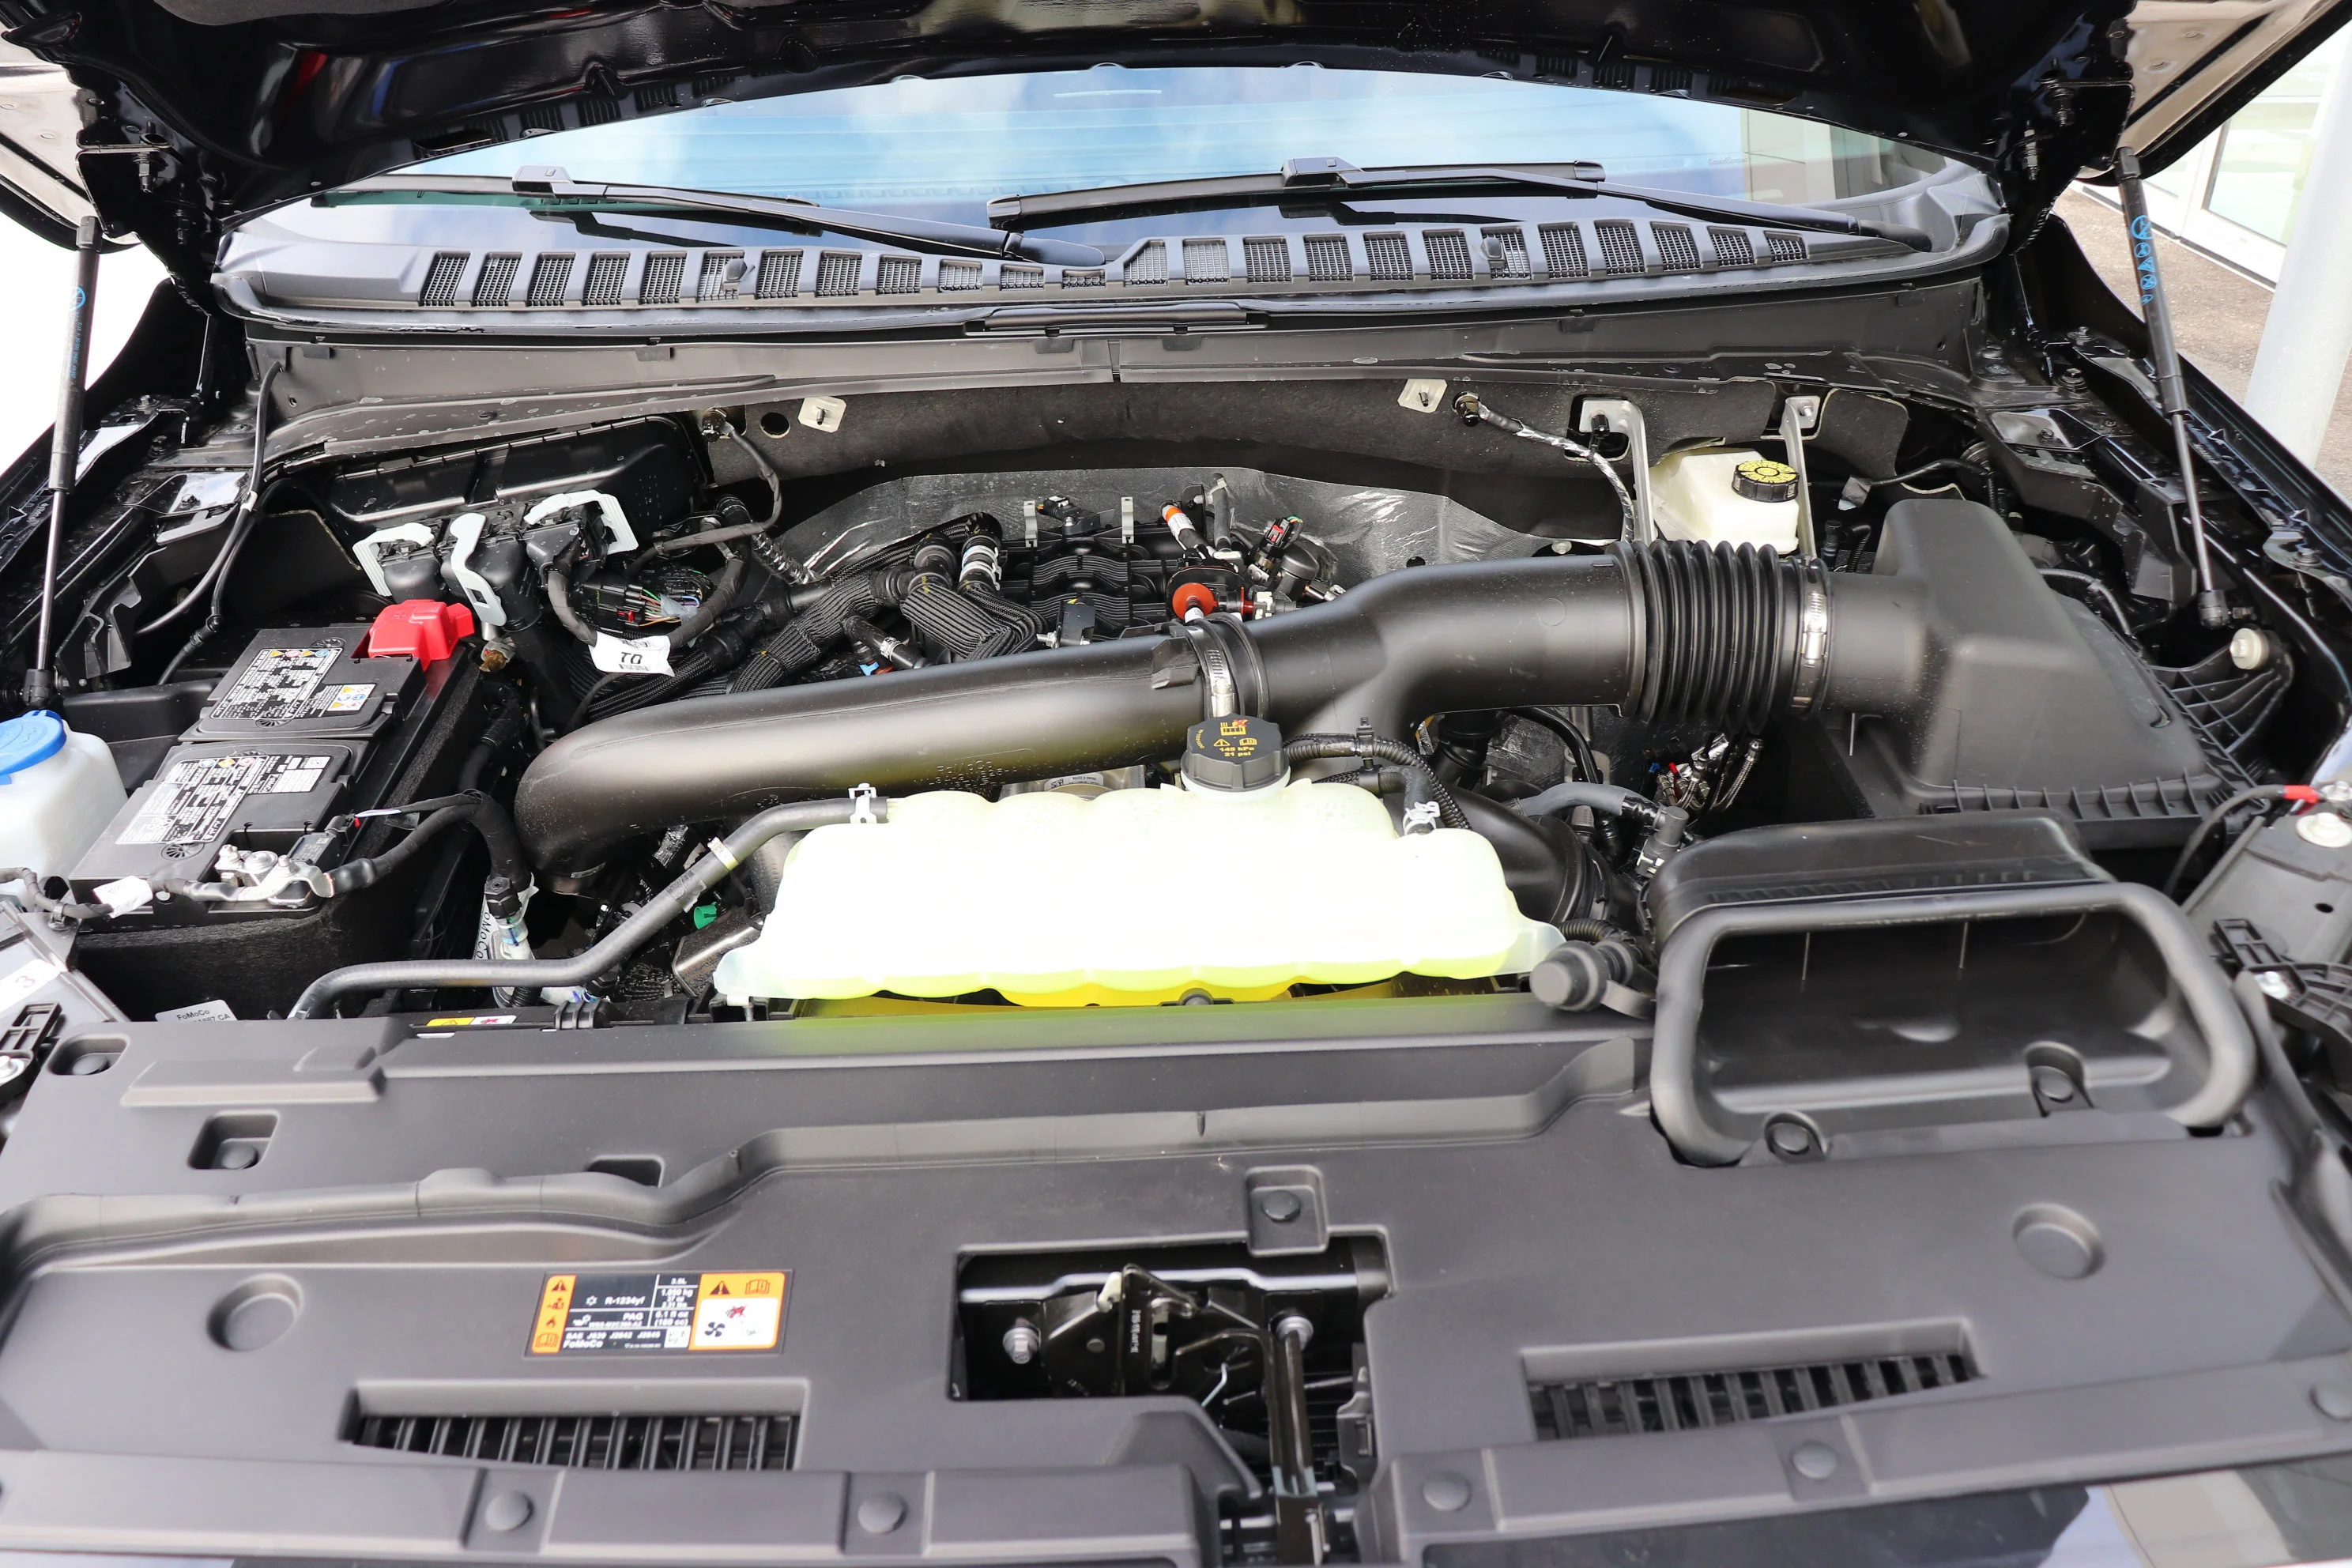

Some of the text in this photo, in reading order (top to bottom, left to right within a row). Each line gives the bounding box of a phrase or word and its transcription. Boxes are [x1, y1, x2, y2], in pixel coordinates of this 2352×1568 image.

[476, 912, 492, 959] oMoCo
[177, 1010, 209, 1020] FoMoCo
[605, 1296, 646, 1306] R-1234yf
[623, 1312, 644, 1321] PAG
[563, 1339, 604, 1349] FoMoCo
